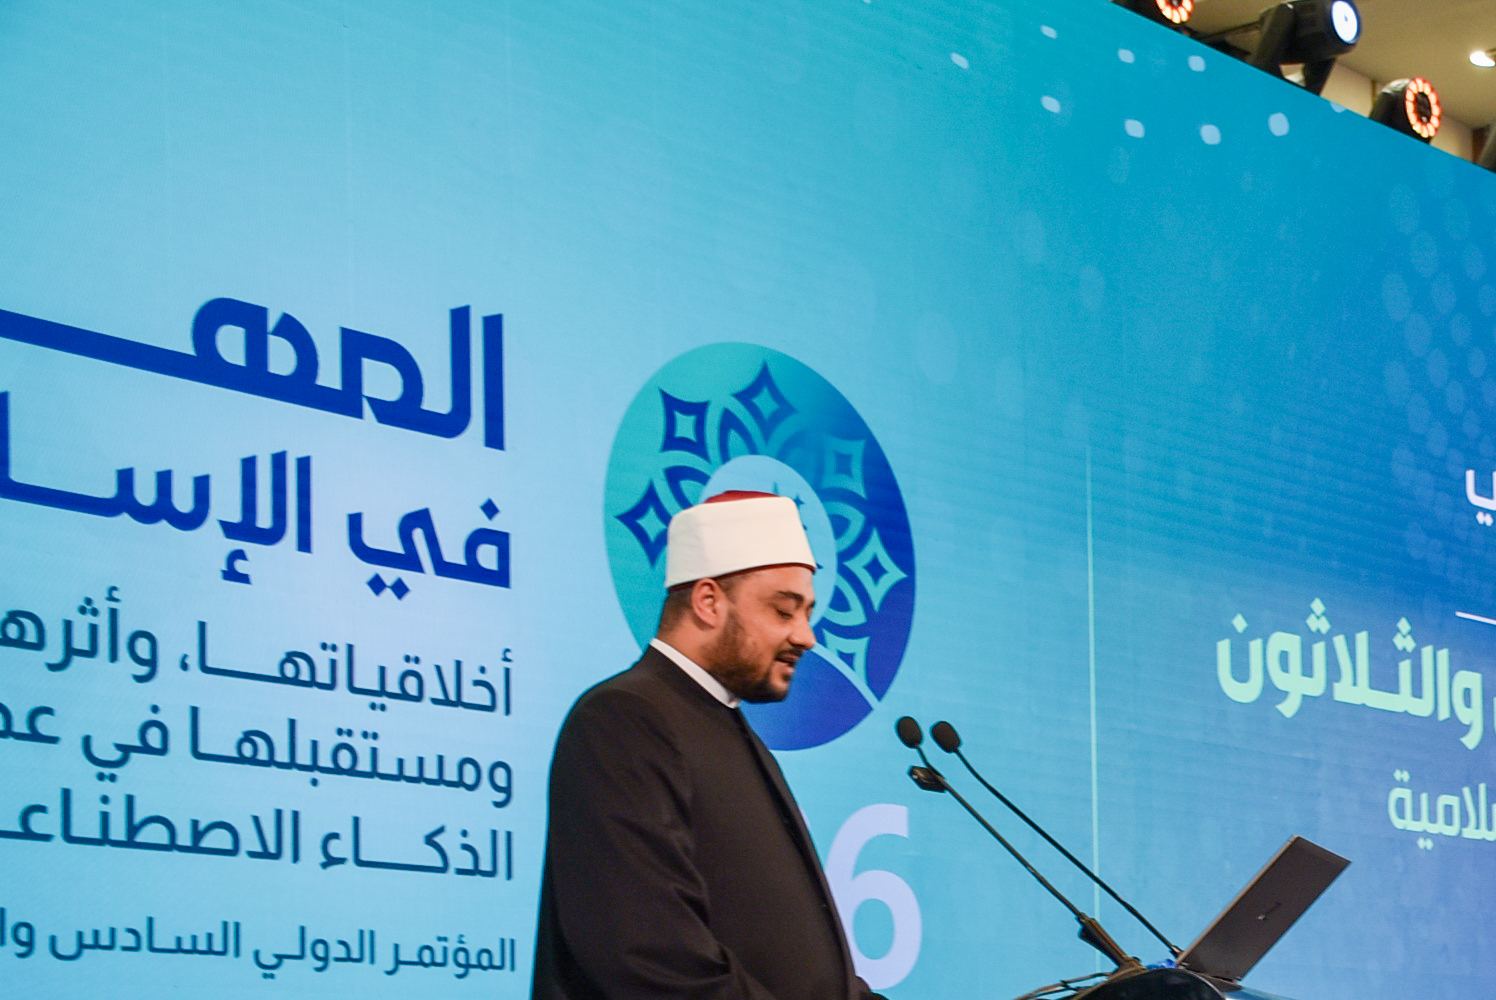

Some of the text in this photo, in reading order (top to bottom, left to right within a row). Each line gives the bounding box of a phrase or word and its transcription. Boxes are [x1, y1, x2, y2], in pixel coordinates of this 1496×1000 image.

[0, 297, 505, 451] المه
[0, 391, 511, 600] في الإسل
[0, 586, 160, 684] وأثره
[1216, 597, 1484, 751] والثلاثون
[82, 704, 169, 783] في
[190, 706, 514, 807] ومستقبلها
[0, 787, 514, 881] الذكاء الاصطناع
[48, 916, 240, 961] السادس
[801, 803, 922, 990] 6
[253, 925, 375, 979] الدولي
[384, 934, 516, 979] المؤتمر
